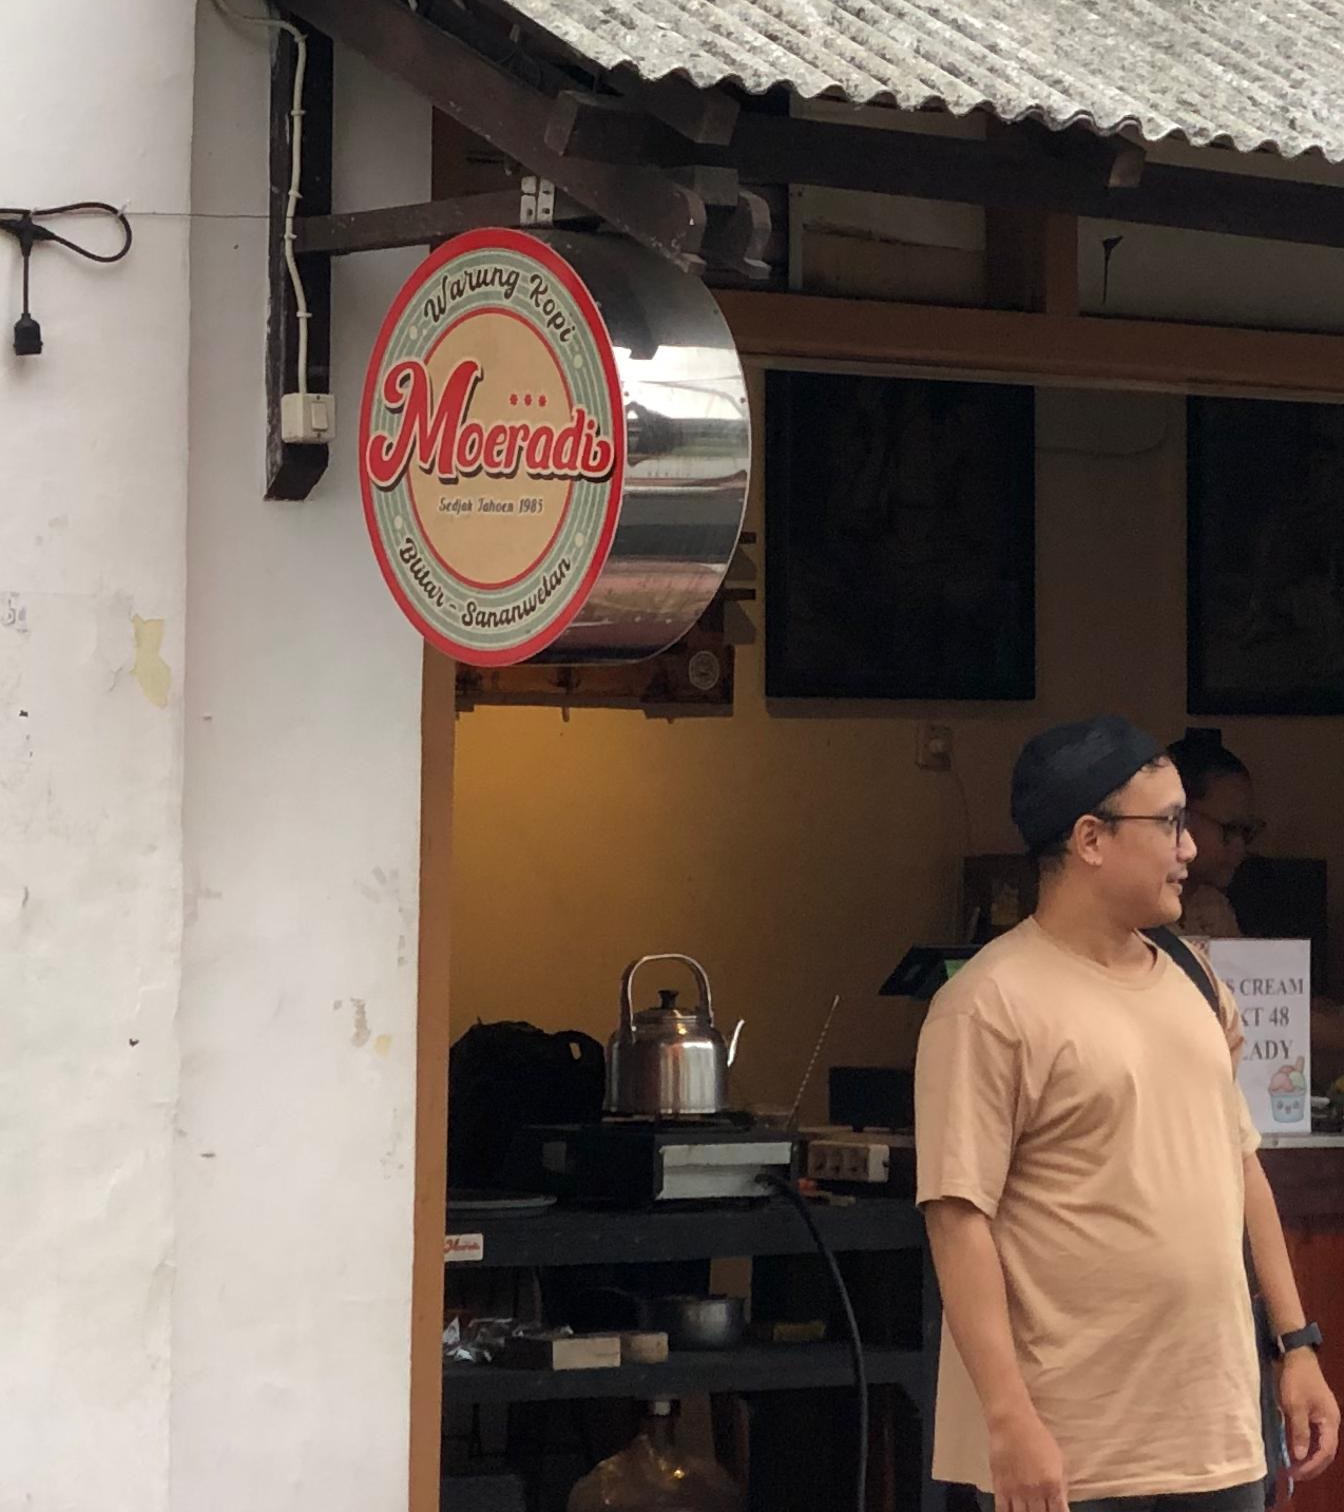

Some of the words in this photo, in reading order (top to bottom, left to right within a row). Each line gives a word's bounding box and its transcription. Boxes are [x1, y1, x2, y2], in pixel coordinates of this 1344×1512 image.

[423, 266, 520, 323] Warung
[529, 273, 576, 342] Kopi
[518, 497, 544, 513] 1985
[399, 537, 445, 608] Blitar
[461, 557, 571, 628] Sananwetan
[1239, 977, 1304, 997] CREAM
[1268, 1006, 1290, 1027] 48
